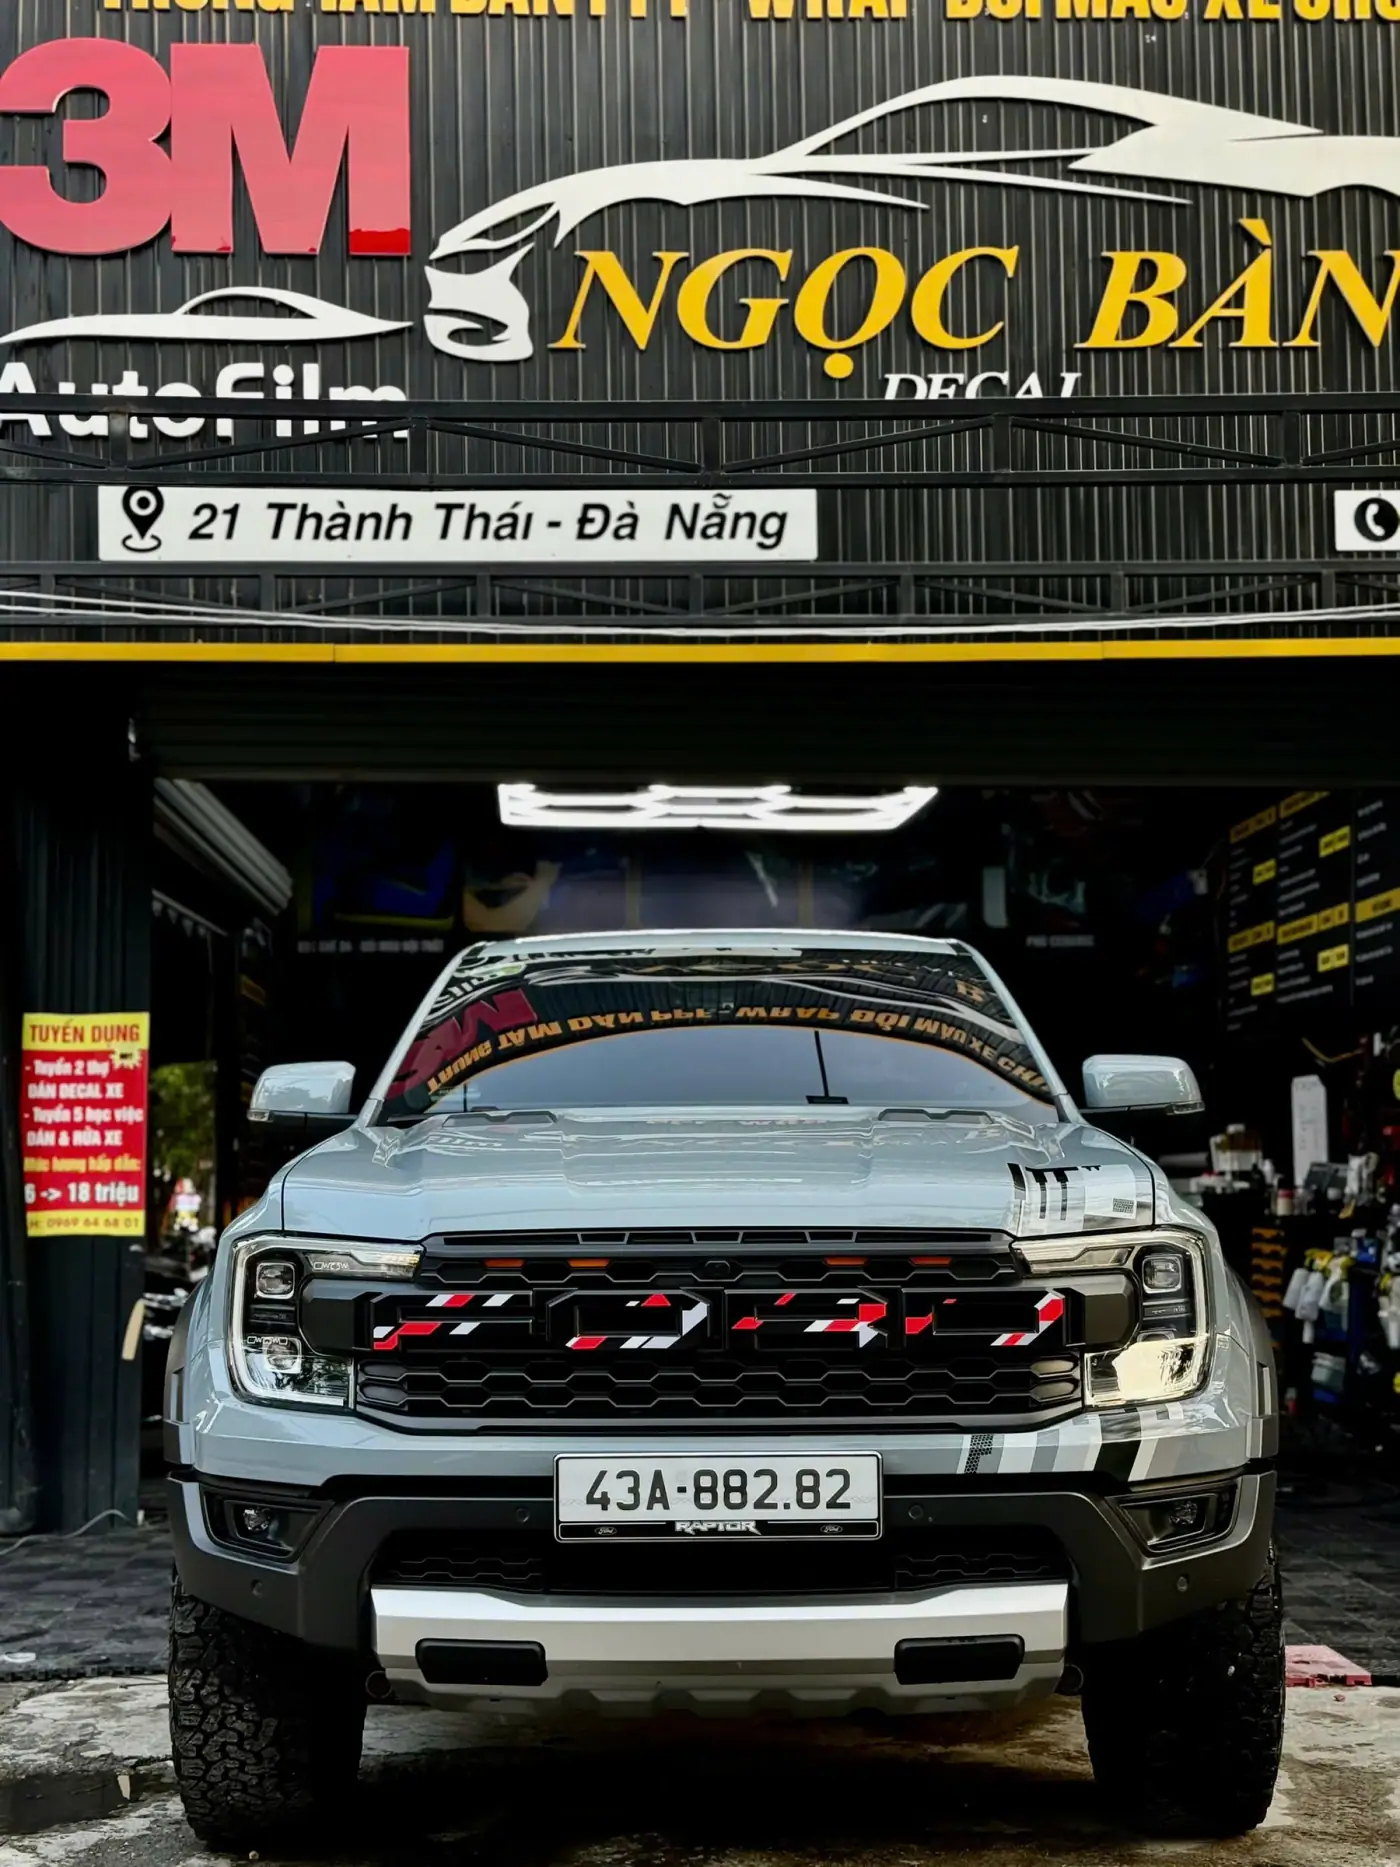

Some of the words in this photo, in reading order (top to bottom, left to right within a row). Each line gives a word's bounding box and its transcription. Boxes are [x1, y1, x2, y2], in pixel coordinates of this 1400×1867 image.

[0, 36, 411, 256] 3M
[547, 246, 1019, 379] NGỌC
[188, 502, 241, 541] 21
[266, 499, 413, 541] Thành
[434, 501, 534, 541] Thái
[547, 520, 562, 528] -
[576, 500, 640, 541] Đà
[665, 492, 788, 550] Nẵng
[67, 1181, 91, 1203] 18
[95, 1181, 139, 1207] triệu
[585, 1468, 851, 1511] 43A-882.82
[674, 1520, 762, 1536] RAPTOR
